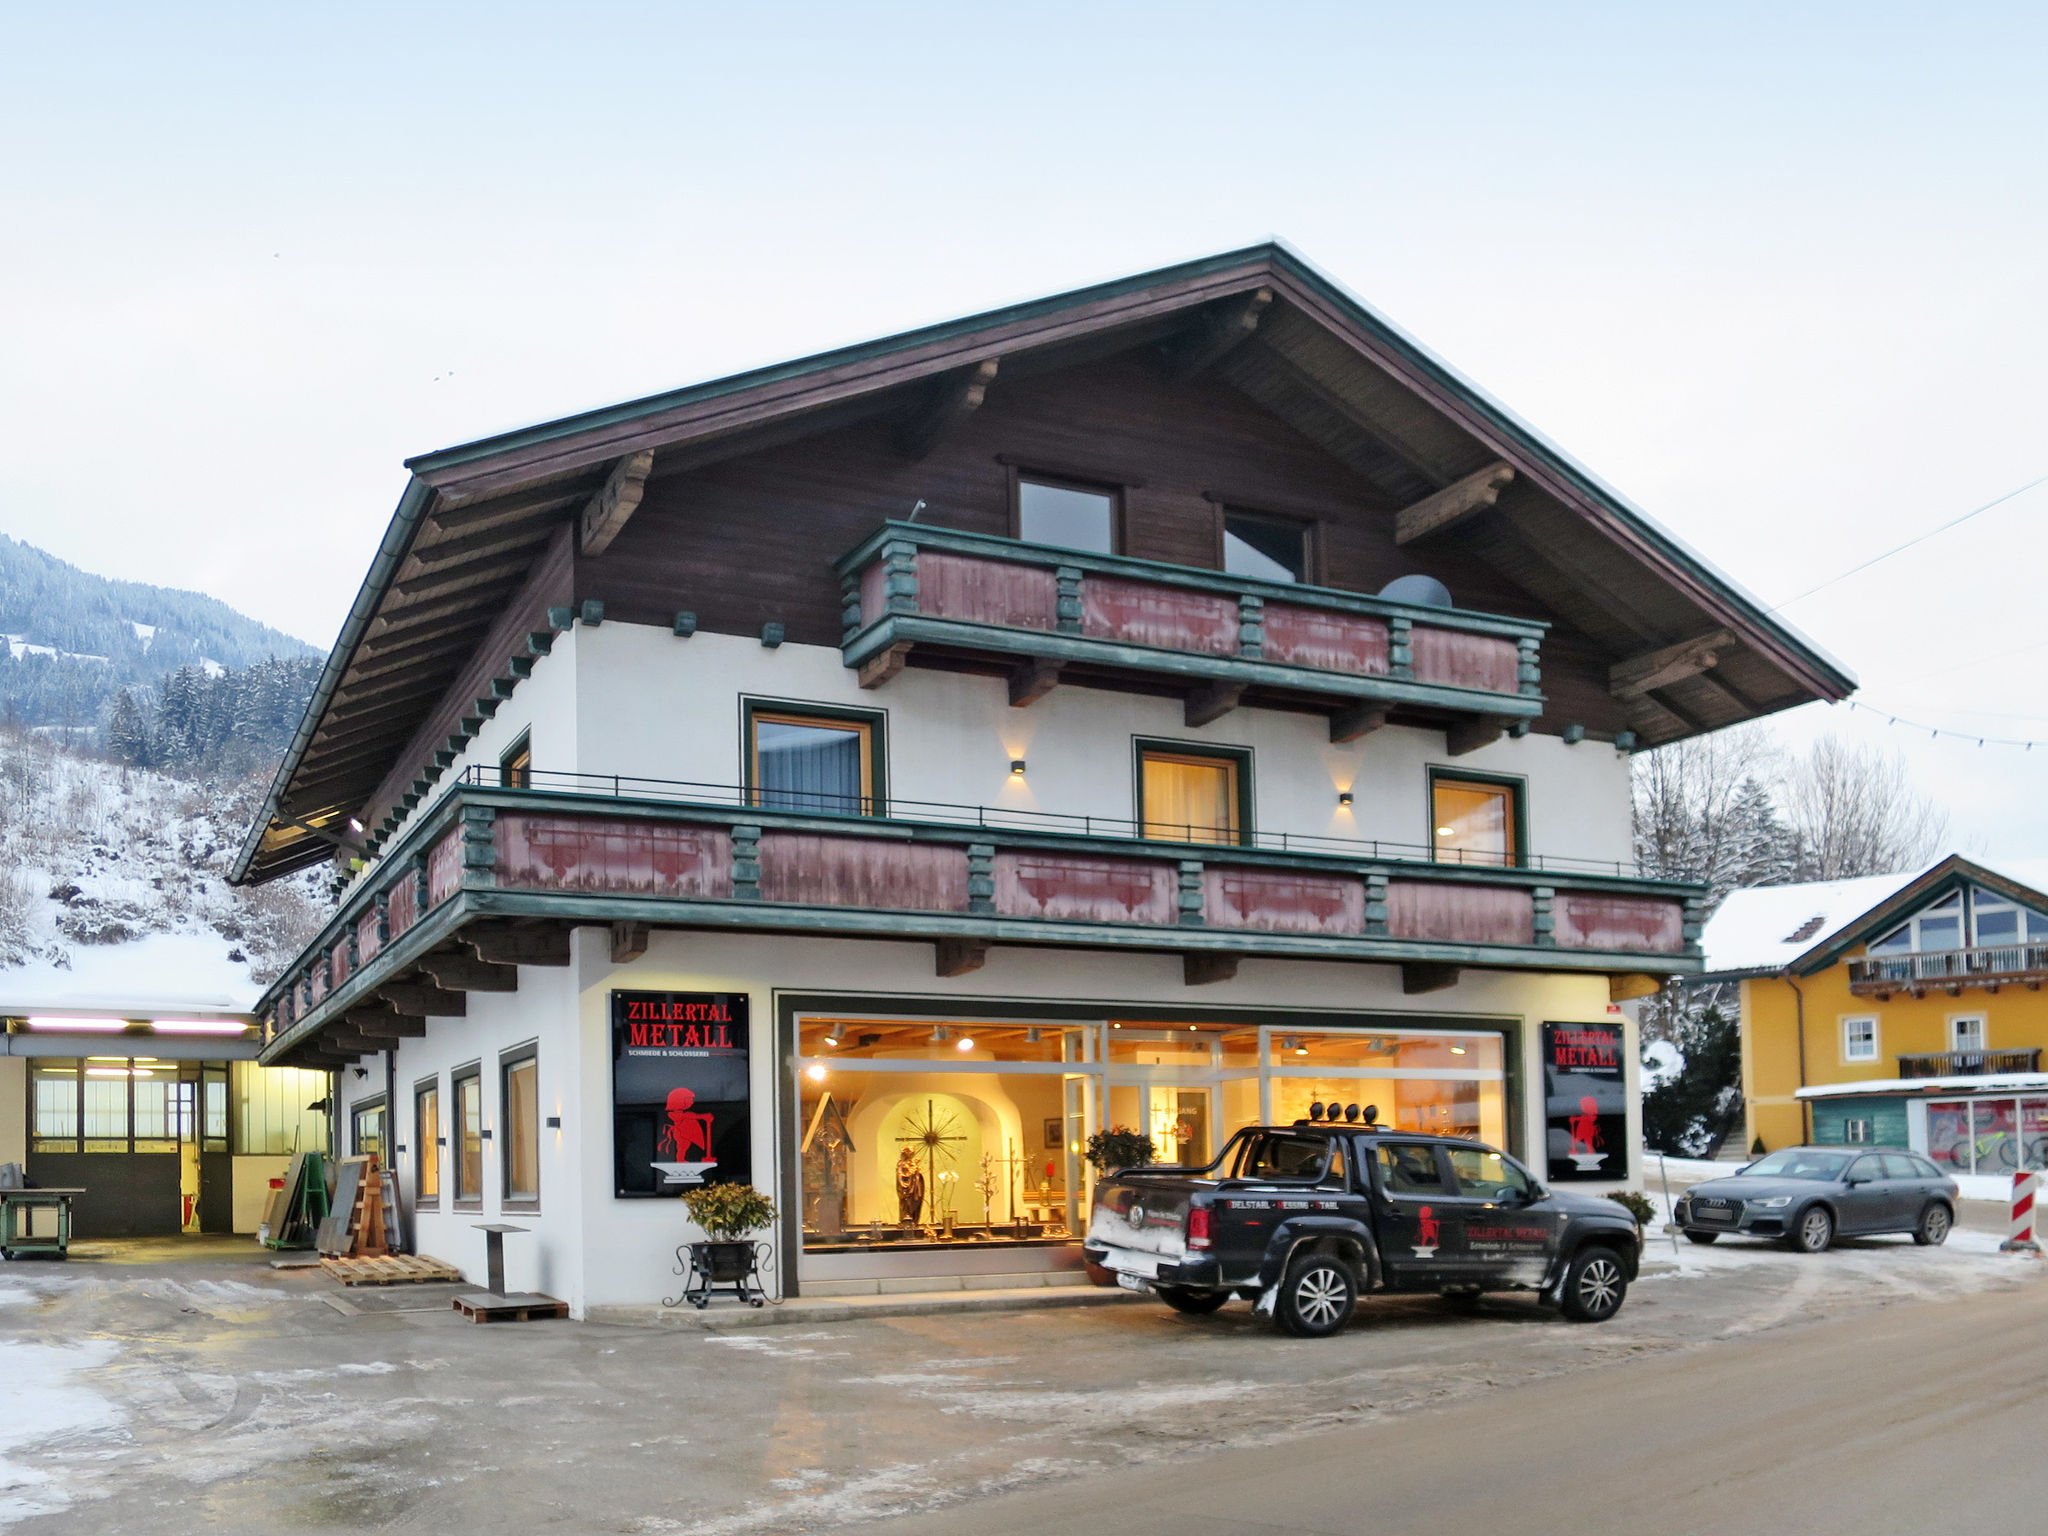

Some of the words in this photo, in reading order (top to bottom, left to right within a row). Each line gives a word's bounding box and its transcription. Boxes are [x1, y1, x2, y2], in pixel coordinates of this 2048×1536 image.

[628, 1002, 732, 1021] ZILLERTAL
[630, 1024, 733, 1047] METALL
[1554, 1031, 1616, 1045] ZILLERTAL
[1556, 1048, 1616, 1065] METALL
